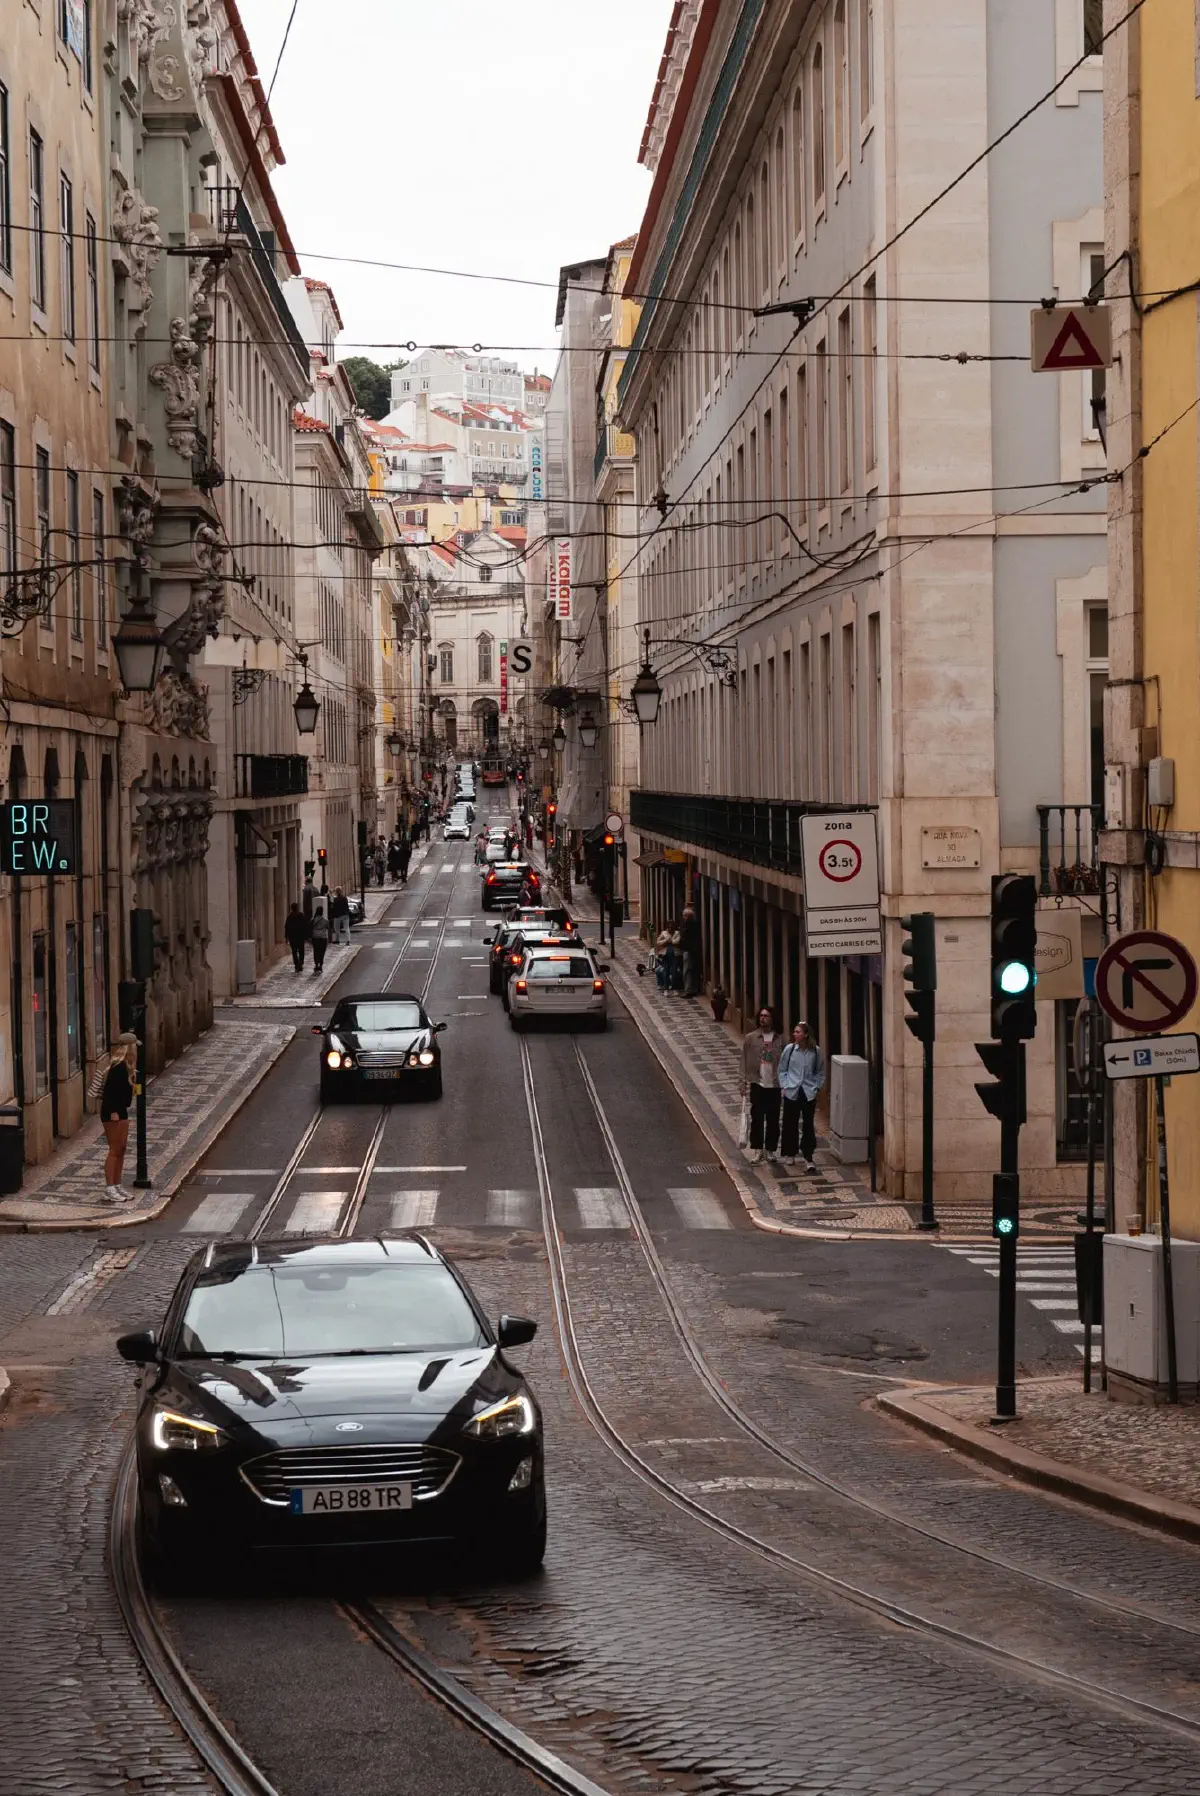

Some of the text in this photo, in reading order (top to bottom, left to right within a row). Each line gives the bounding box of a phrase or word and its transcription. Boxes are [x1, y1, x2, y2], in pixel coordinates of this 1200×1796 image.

[511, 645, 532, 673] S
[12, 805, 49, 834] BR
[824, 822, 852, 830] zona
[828, 854, 853, 868] 3.5t
[1154, 1050, 1173, 1058] Baixa
[1174, 1047, 1197, 1055] Chiado
[313, 1490, 344, 1510] AB
[347, 1489, 371, 1508] 88
[375, 1486, 402, 1507] TR
